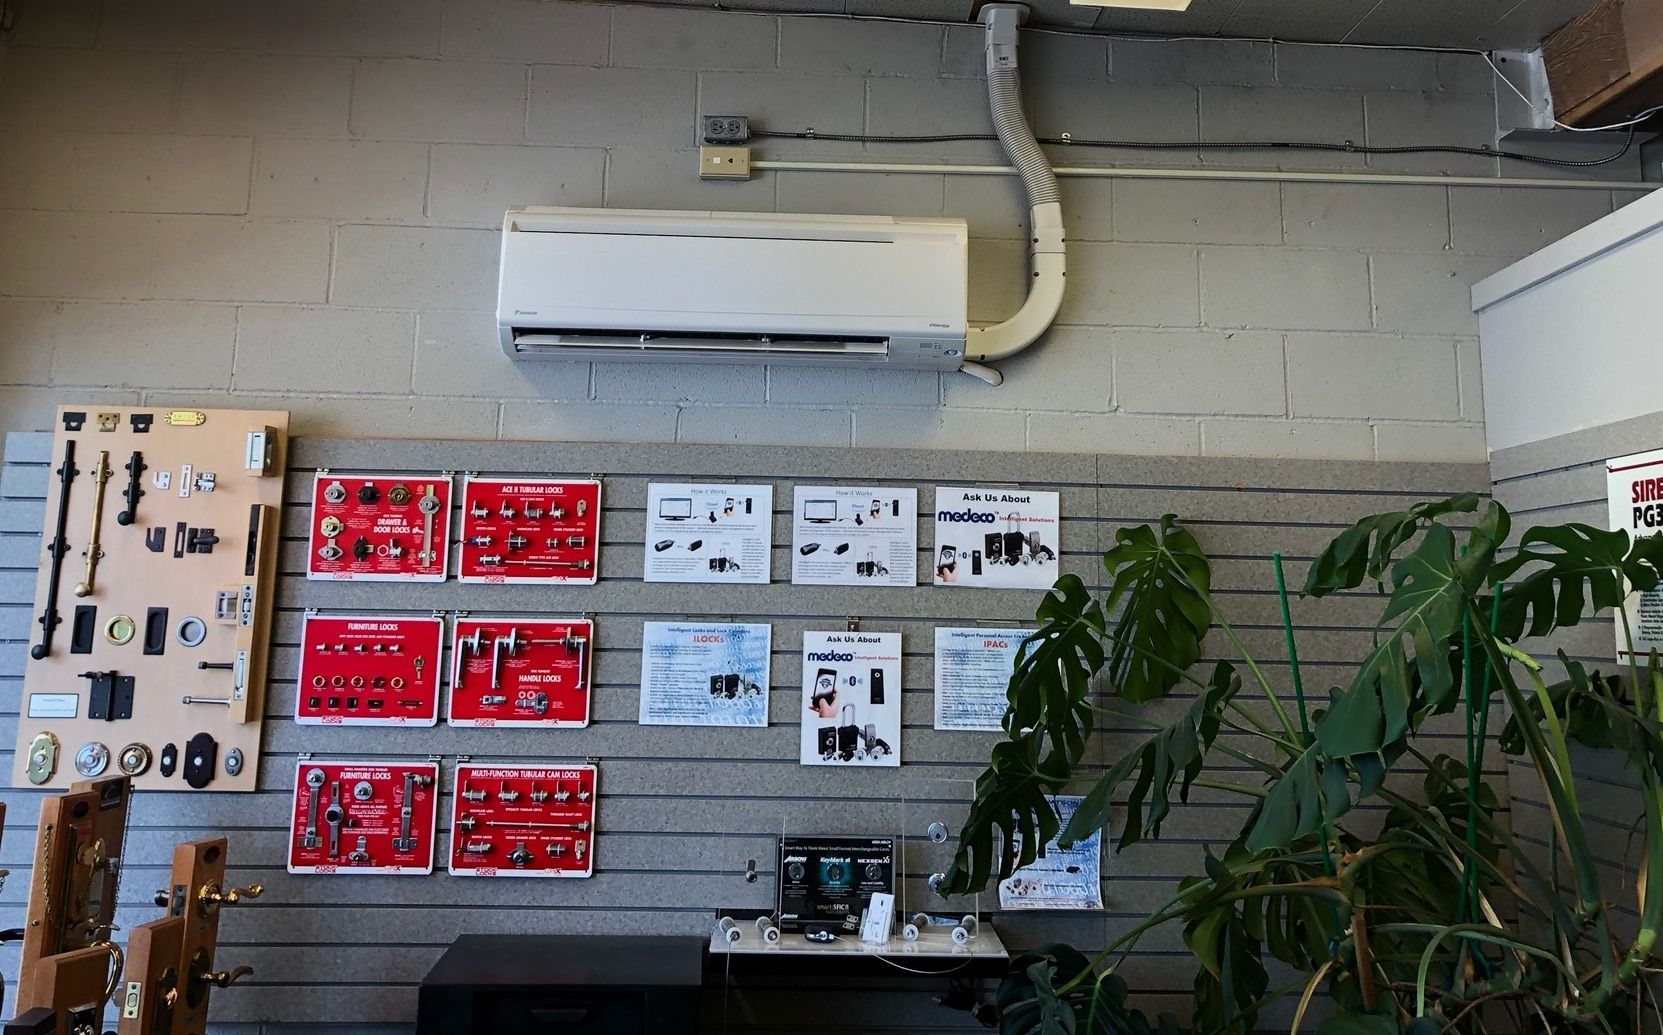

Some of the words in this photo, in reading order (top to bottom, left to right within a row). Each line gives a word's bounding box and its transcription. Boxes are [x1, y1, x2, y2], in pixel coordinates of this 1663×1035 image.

[519, 486, 544, 494] TUBULAR
[545, 486, 564, 494] LOCKS
[1632, 477, 1663, 503] SIRE
[962, 494, 982, 502] Ask
[985, 494, 998, 502] Us
[1000, 495, 1030, 503] About
[938, 508, 995, 523] medeco
[1633, 503, 1663, 528] PG3
[984, 640, 1008, 648] IPACs
[808, 650, 853, 662] medeco
[543, 675, 561, 683] LOCKS
[340, 771, 372, 779] FURNITURE
[372, 772, 391, 780] LOCKS
[471, 770, 519, 778] MULTI-FUNCTION
[520, 770, 545, 778] TUBULAR
[561, 771, 580, 779] LOCKS
